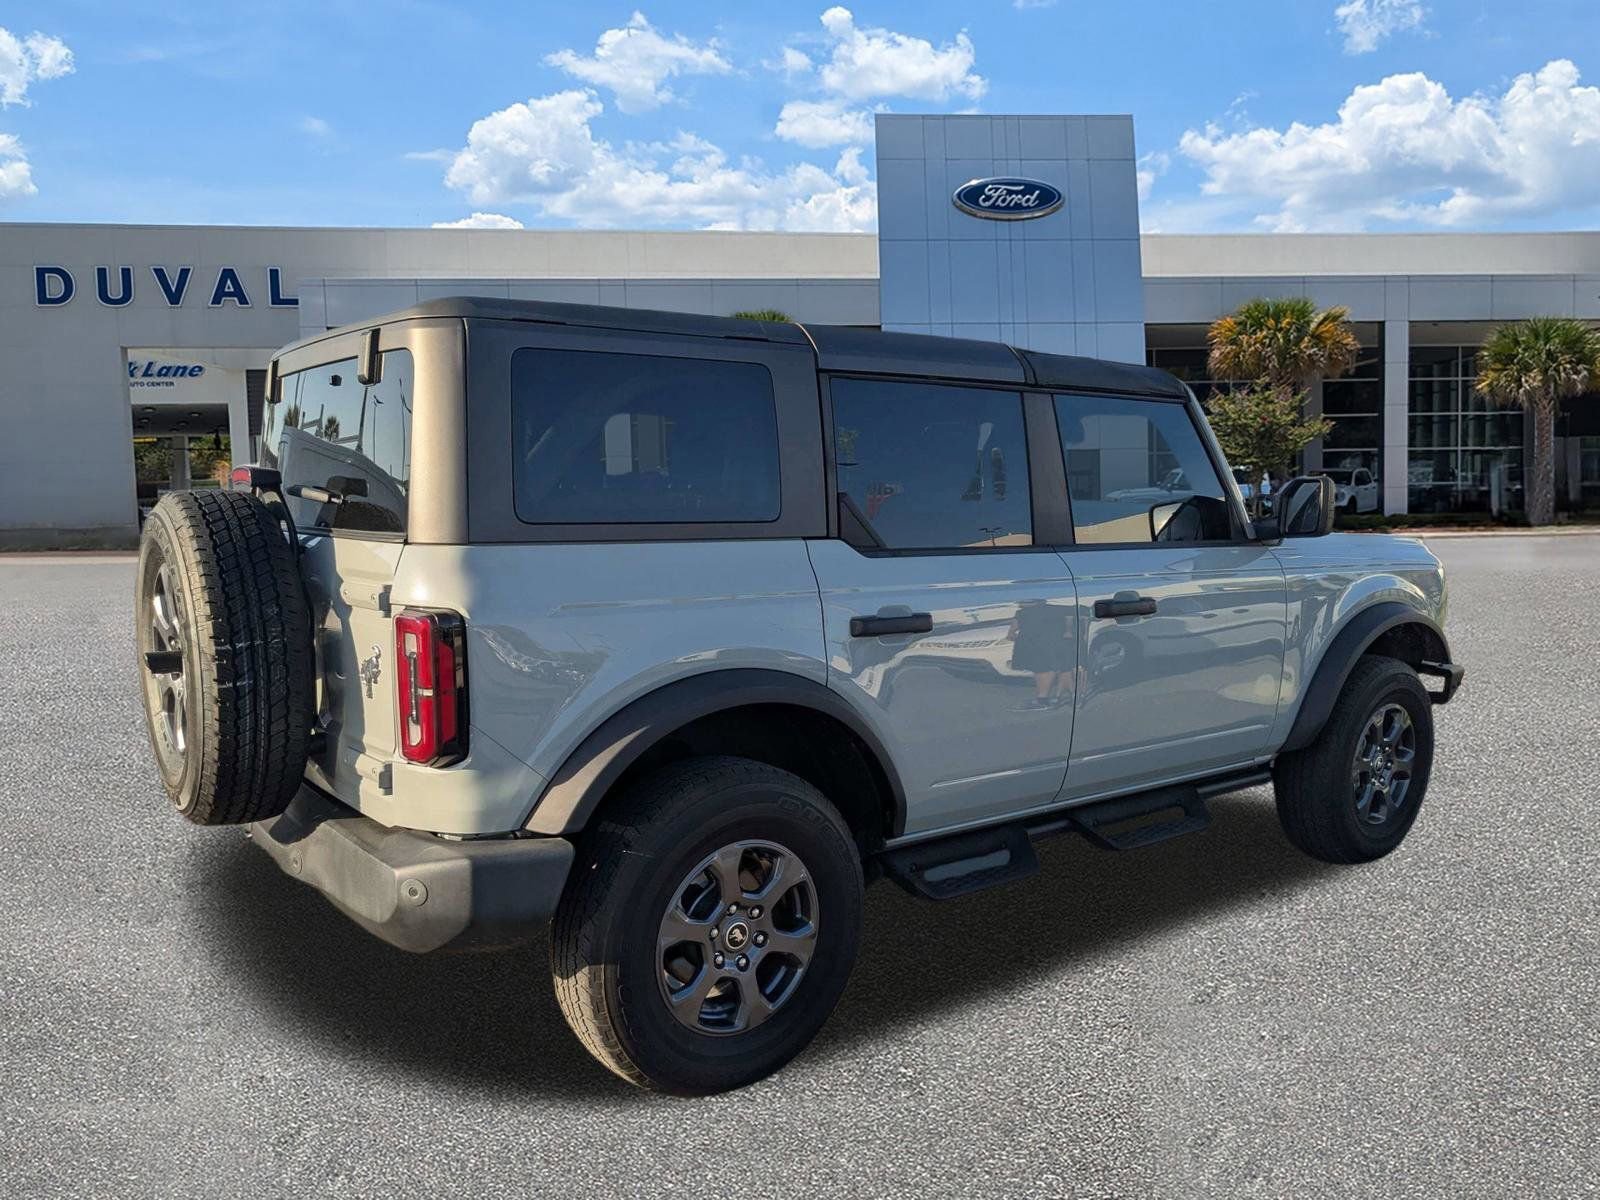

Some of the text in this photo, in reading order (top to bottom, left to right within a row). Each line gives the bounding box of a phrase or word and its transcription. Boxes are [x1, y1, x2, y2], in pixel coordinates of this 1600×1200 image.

[978, 184, 1040, 208] Ford
[34, 265, 299, 308] DUVAL
[141, 361, 204, 378] Lane
